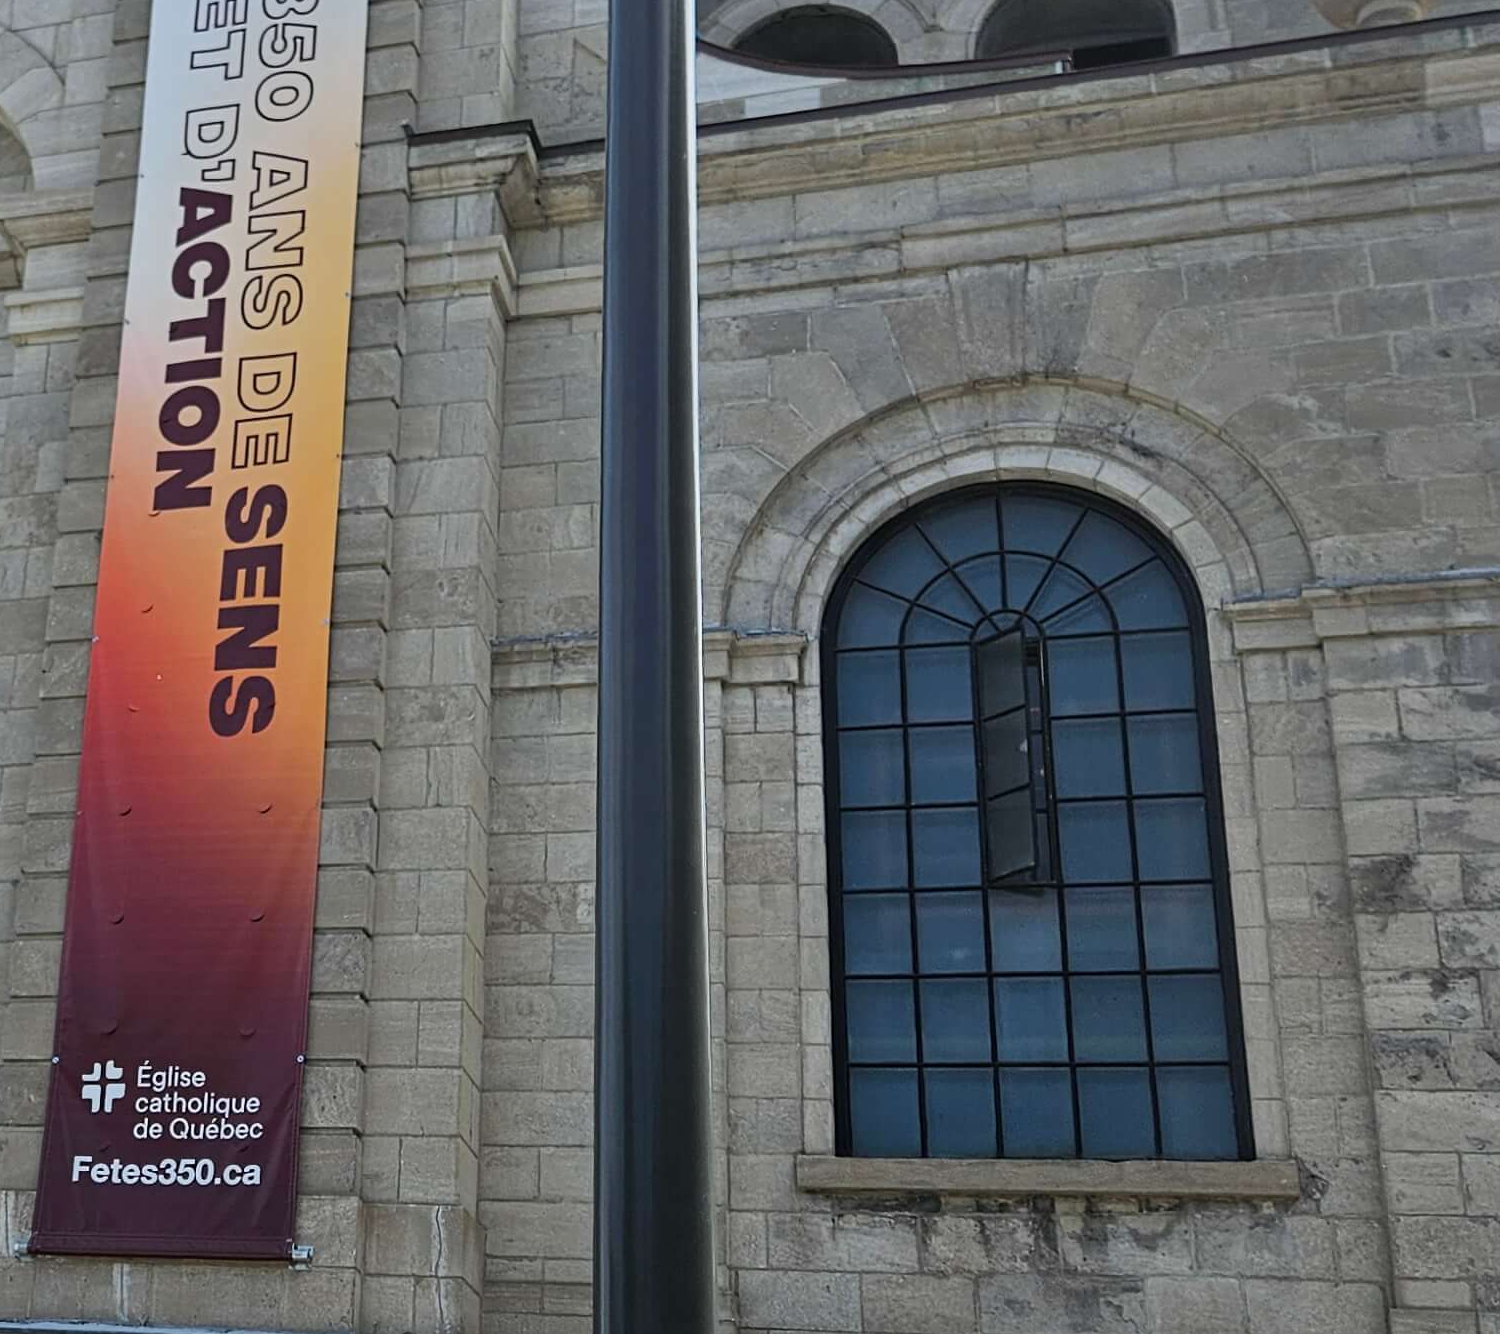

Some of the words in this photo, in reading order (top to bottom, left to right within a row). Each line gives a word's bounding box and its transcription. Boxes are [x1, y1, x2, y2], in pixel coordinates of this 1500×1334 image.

[241, 151, 311, 330] ANS
[153, 105, 241, 512] D'ACTION
[230, 352, 298, 469] DE
[209, 487, 288, 737] SENS
[135, 1092, 260, 1118] catholique
[138, 1060, 206, 1090] Église
[133, 1118, 163, 1139] de
[170, 1118, 263, 1139] Québec
[72, 1156, 261, 1186] Fetes350.ca
